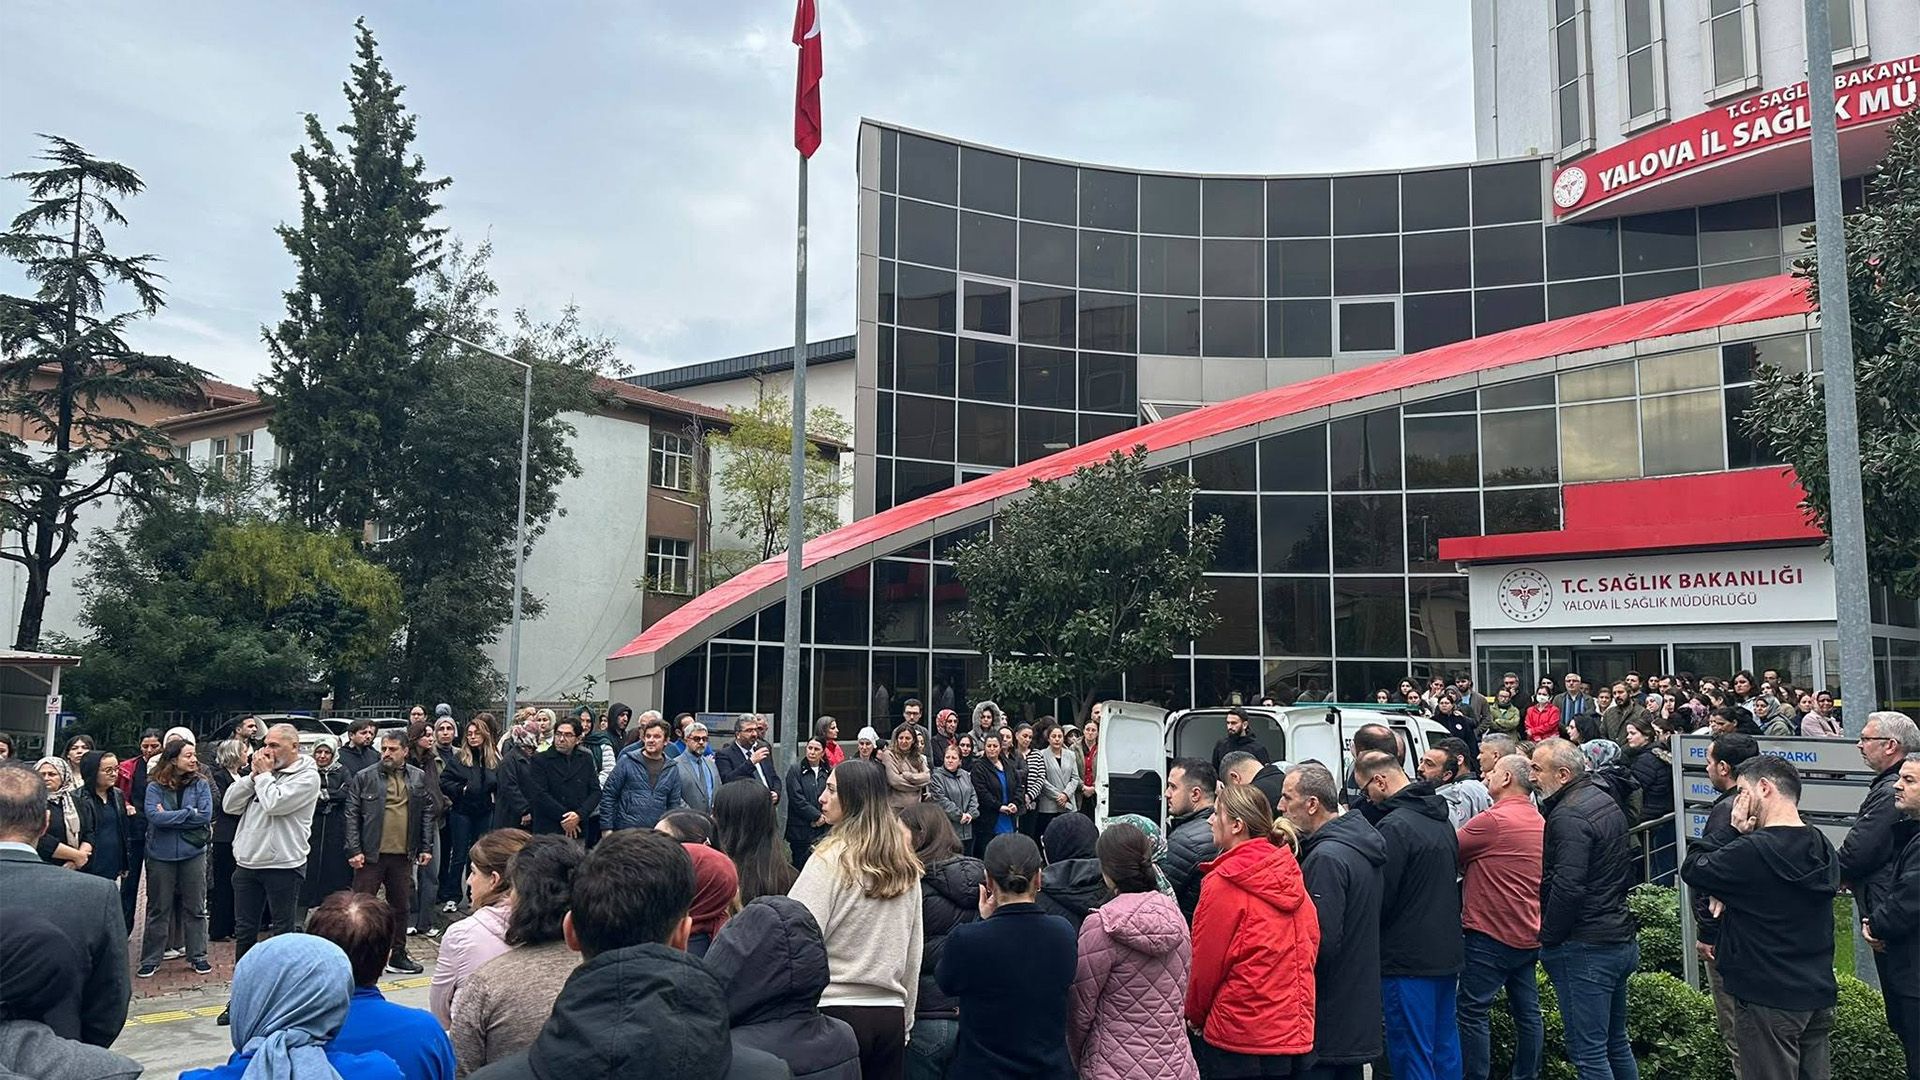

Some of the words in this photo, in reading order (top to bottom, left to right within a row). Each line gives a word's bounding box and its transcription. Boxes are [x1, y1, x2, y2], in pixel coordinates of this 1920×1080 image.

[1726, 101, 1757, 119] T.C.
[1759, 83, 1811, 110] SAĞL
[1834, 58, 1920, 90] BAKANL
[1598, 141, 1696, 193] YALOVA
[1701, 128, 1727, 157] İL
[1733, 94, 1851, 149] SAĞLK
[1859, 75, 1918, 116] MÜ
[1561, 579, 1594, 594] T.C.
[1598, 573, 1672, 592] SAĞLIK
[1679, 565, 1803, 589] BAKANLIĞI
[1562, 599, 1608, 611] YALOVA
[1611, 597, 1620, 610] İL
[1624, 596, 1668, 609] SAĞLIK
[1670, 592, 1757, 608] MÜDÜRLÜĞÜ
[1690, 747, 1708, 758] PE
[1761, 750, 1817, 763] TOPARKI
